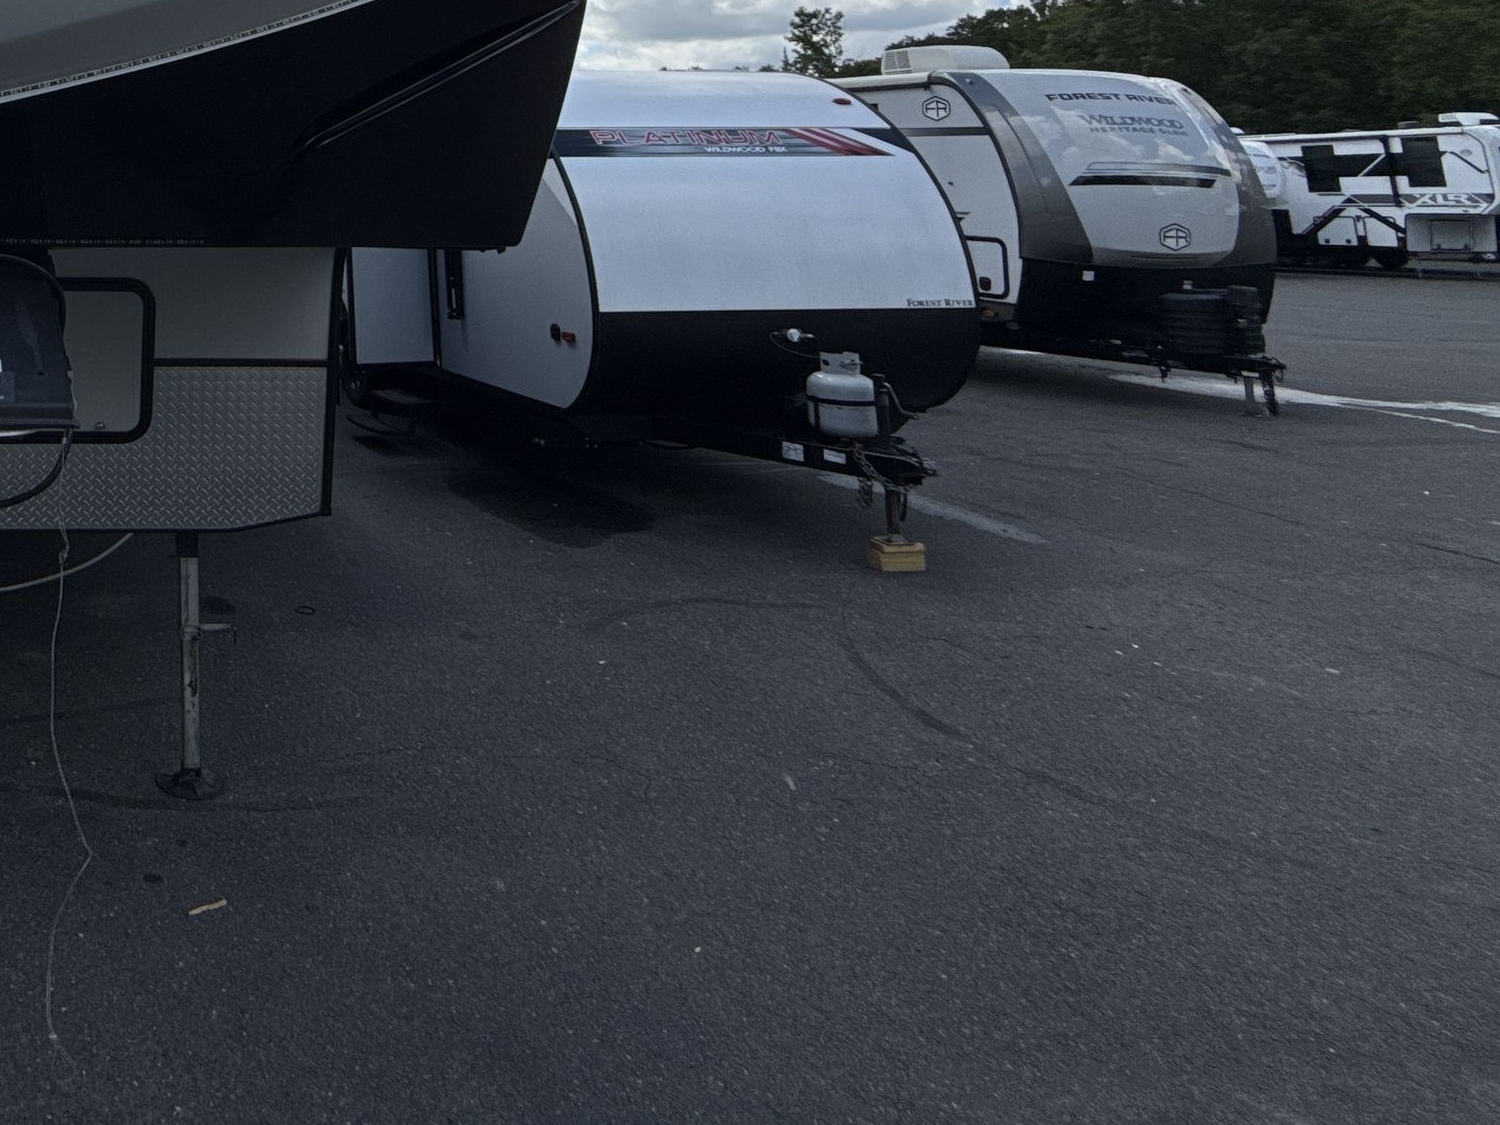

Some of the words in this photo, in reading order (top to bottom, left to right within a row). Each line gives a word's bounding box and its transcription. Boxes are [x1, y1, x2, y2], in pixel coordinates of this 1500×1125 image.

[1045, 92, 1122, 102] FOREST
[1123, 93, 1178, 106] RIVER
[1077, 114, 1184, 129] WILDWOOD
[589, 130, 783, 145] PLATINUM
[906, 298, 942, 307] FOREST
[944, 298, 973, 307] RIVER
